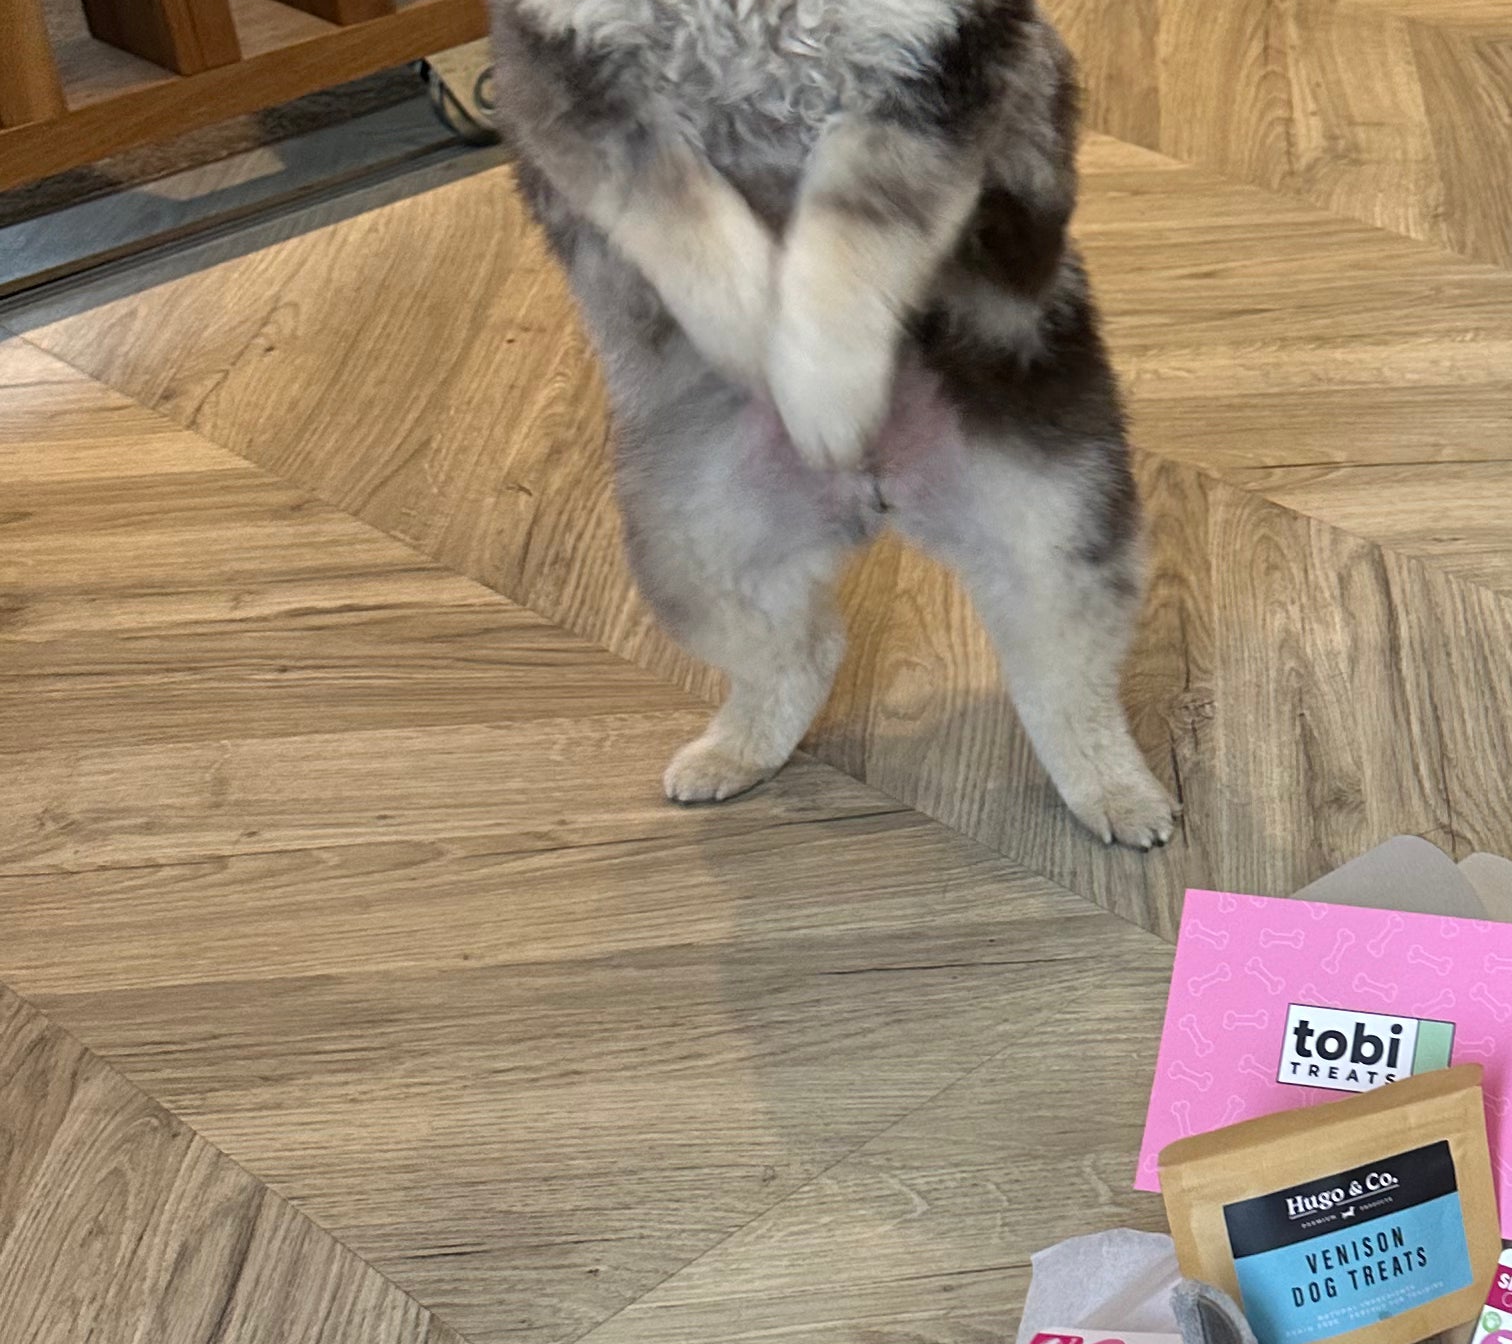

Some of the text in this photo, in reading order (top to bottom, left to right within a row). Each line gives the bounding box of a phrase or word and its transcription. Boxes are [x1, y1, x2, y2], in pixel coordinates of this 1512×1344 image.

[1293, 1019, 1403, 1069] tobi
[1290, 1061, 1398, 1086] TREATS
[1285, 1171, 1399, 1217] Hugo & Co.
[1305, 1226, 1406, 1275] VENISON
[1291, 1246, 1428, 1309] DOG TREATS
